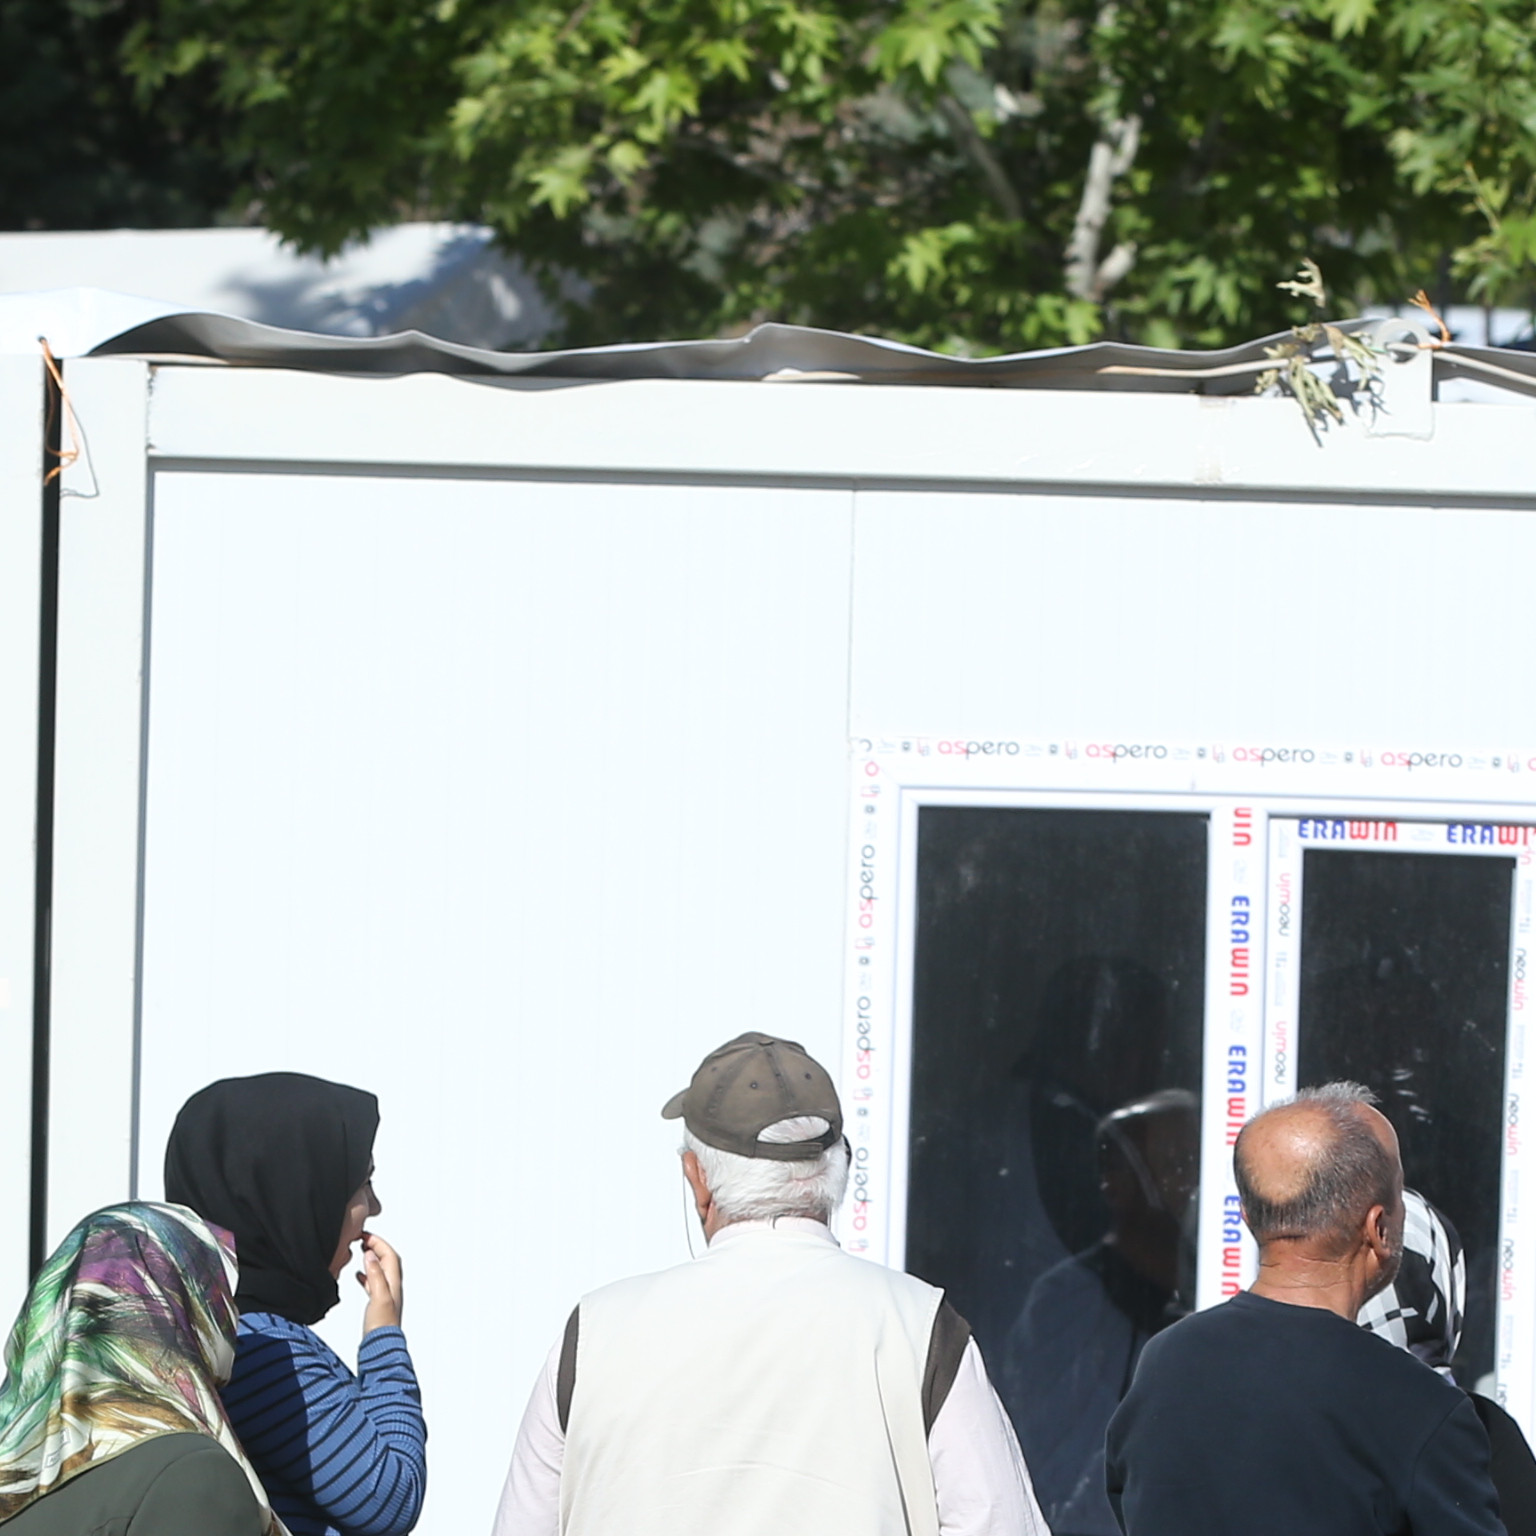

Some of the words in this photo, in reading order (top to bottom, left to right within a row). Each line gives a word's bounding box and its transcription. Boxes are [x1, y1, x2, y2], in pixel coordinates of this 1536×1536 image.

[938, 741, 1020, 760] aspero
[1086, 744, 1168, 763] aspero
[1233, 748, 1315, 766] aspero
[1381, 752, 1463, 771] aspero
[859, 844, 878, 928] aspero
[857, 996, 876, 1079] aspero
[853, 1146, 872, 1230] aspero
